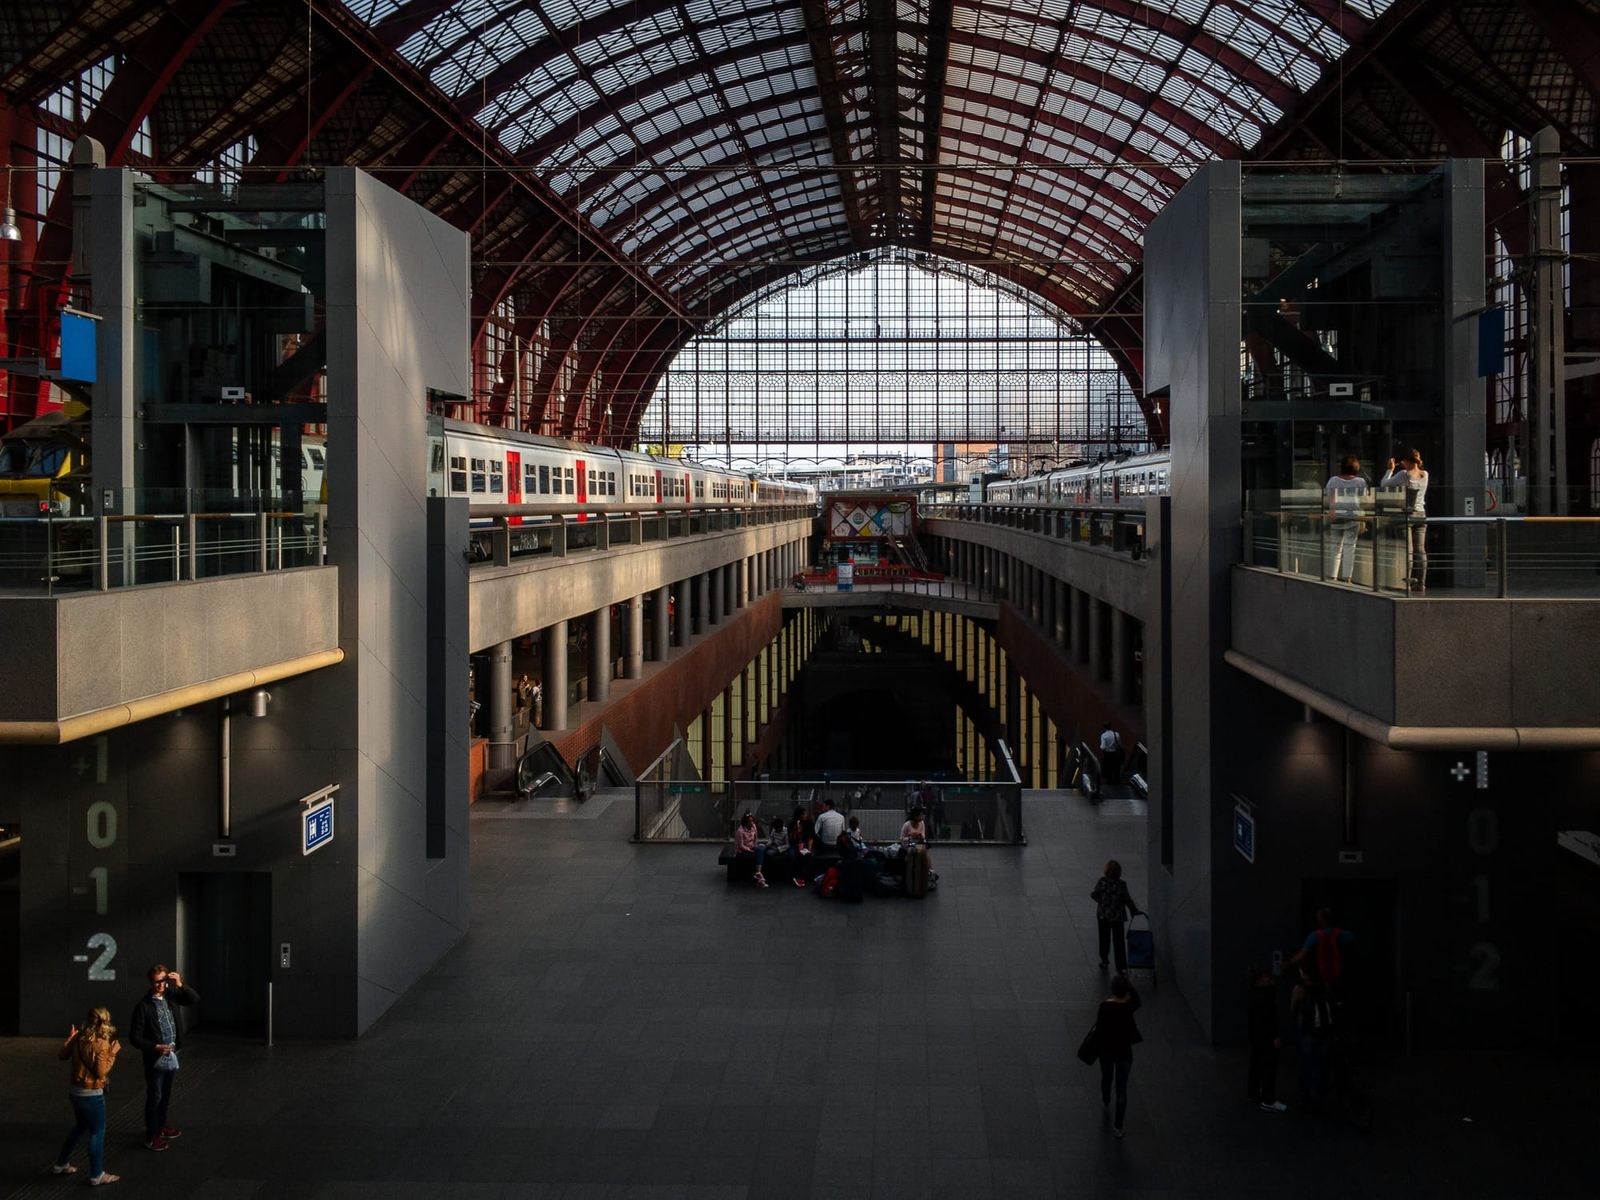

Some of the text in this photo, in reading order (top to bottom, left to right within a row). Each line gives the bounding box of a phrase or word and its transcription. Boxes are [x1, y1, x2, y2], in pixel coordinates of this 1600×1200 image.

[87, 800, 117, 849] 0
[1467, 807, 1499, 855] 0
[72, 866, 108, 915] -1
[72, 932, 117, 981] -2
